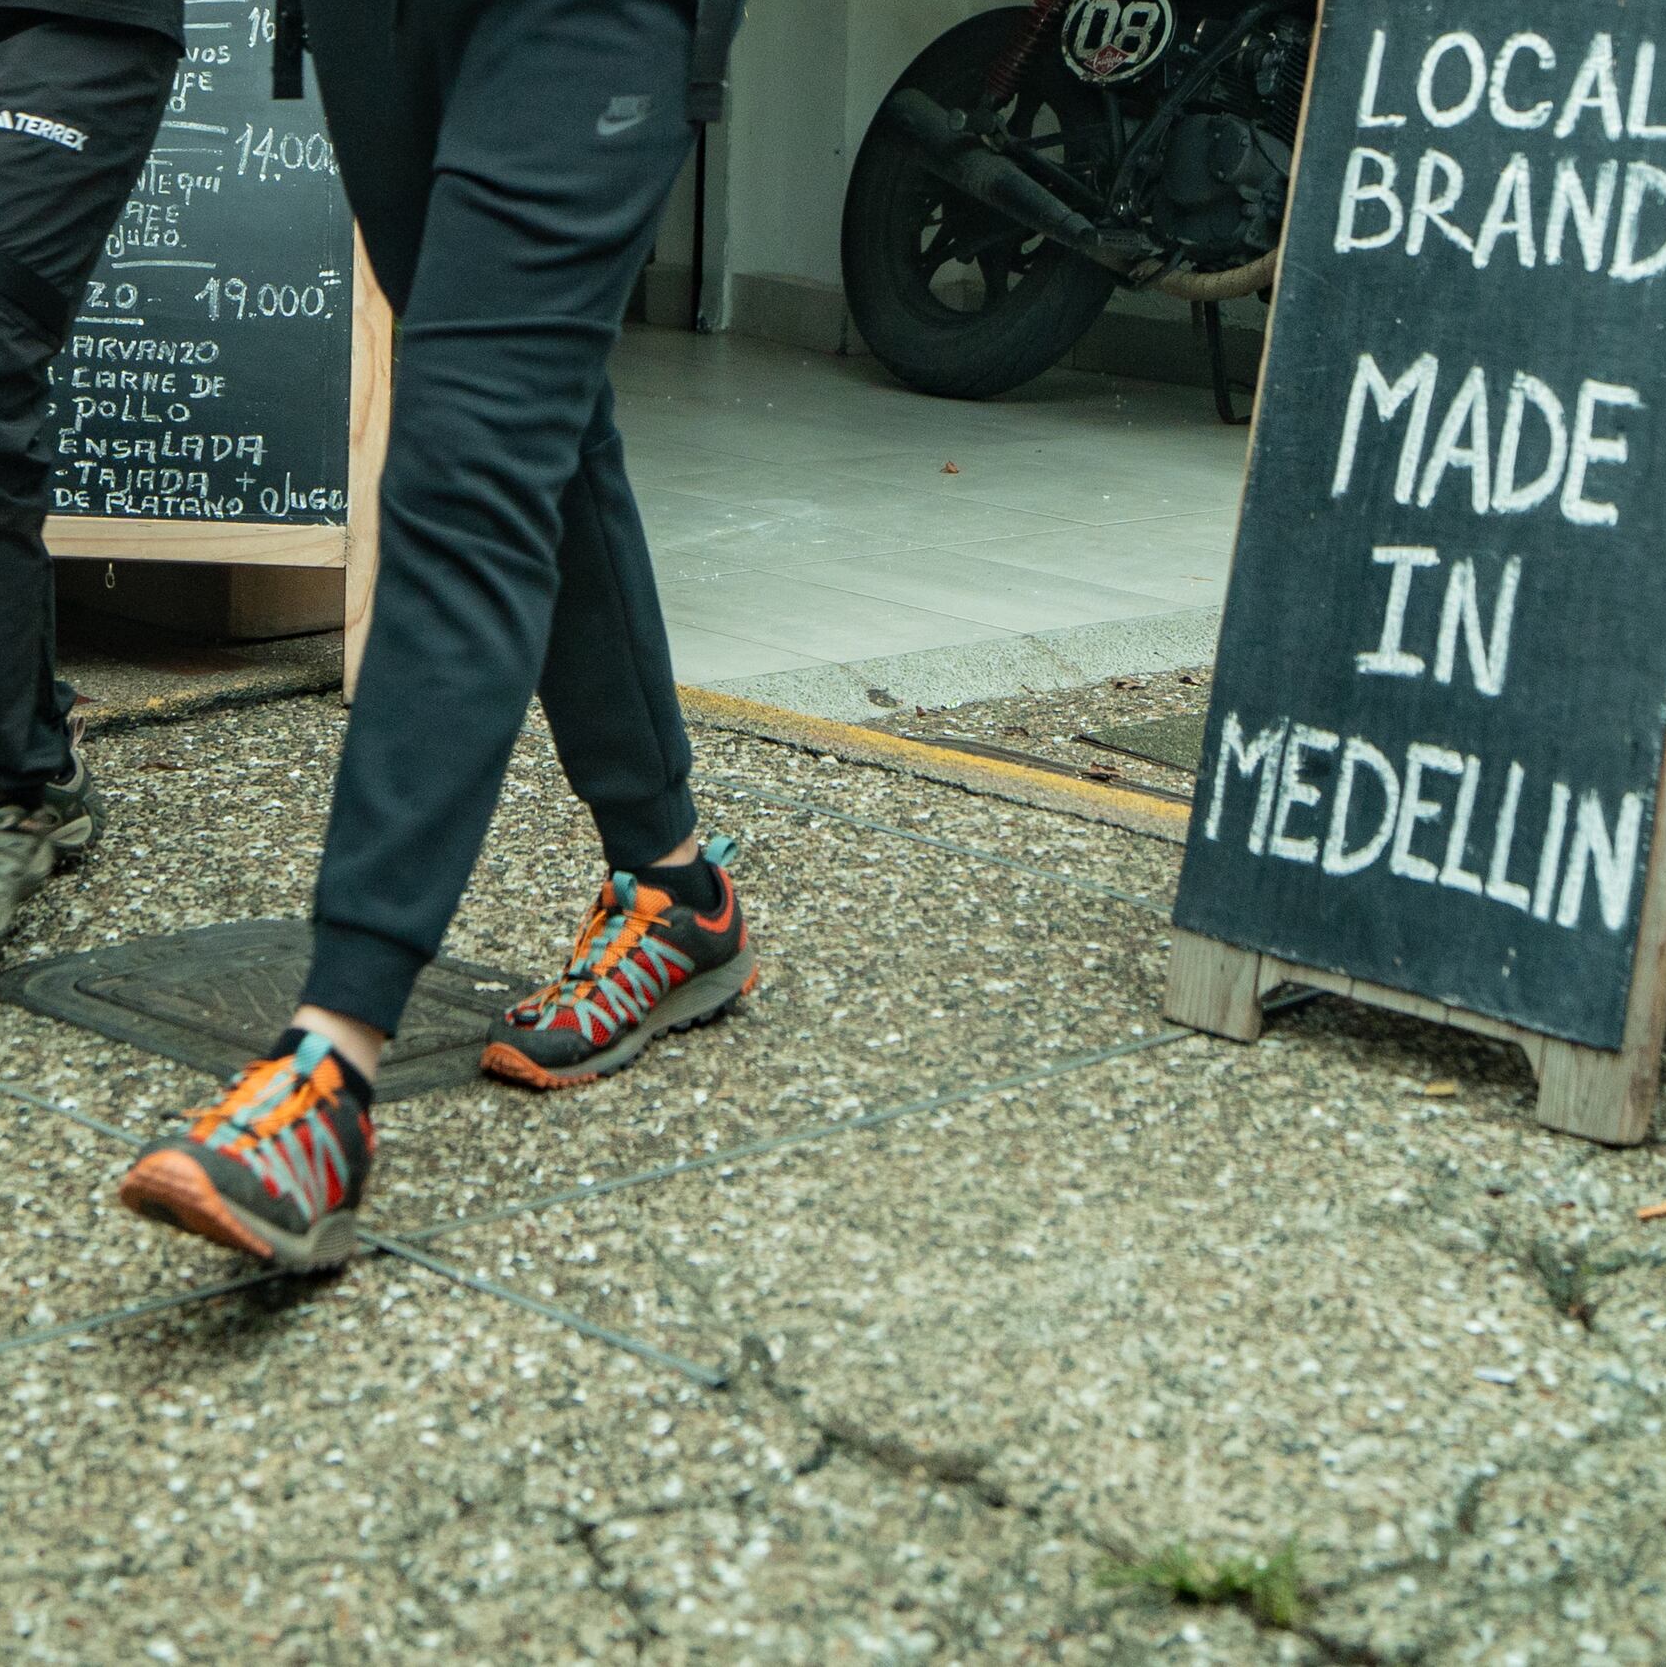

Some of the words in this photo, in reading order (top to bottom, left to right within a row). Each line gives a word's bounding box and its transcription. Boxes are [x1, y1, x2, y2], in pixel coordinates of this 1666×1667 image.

[14, 112, 90, 151] TERREX
[124, 200, 179, 224] AFE
[61, 334, 220, 365] ARVANZO
[71, 366, 177, 394] CARNE
[190, 372, 226, 399] DE
[71, 394, 191, 432] POLLO
[58, 427, 268, 466] ENSALADA
[1331, 350, 1646, 527] MADE
[53, 486, 91, 508] DE
[1355, 545, 1522, 697] IN
[1205, 710, 1645, 932] MEDELLIN
